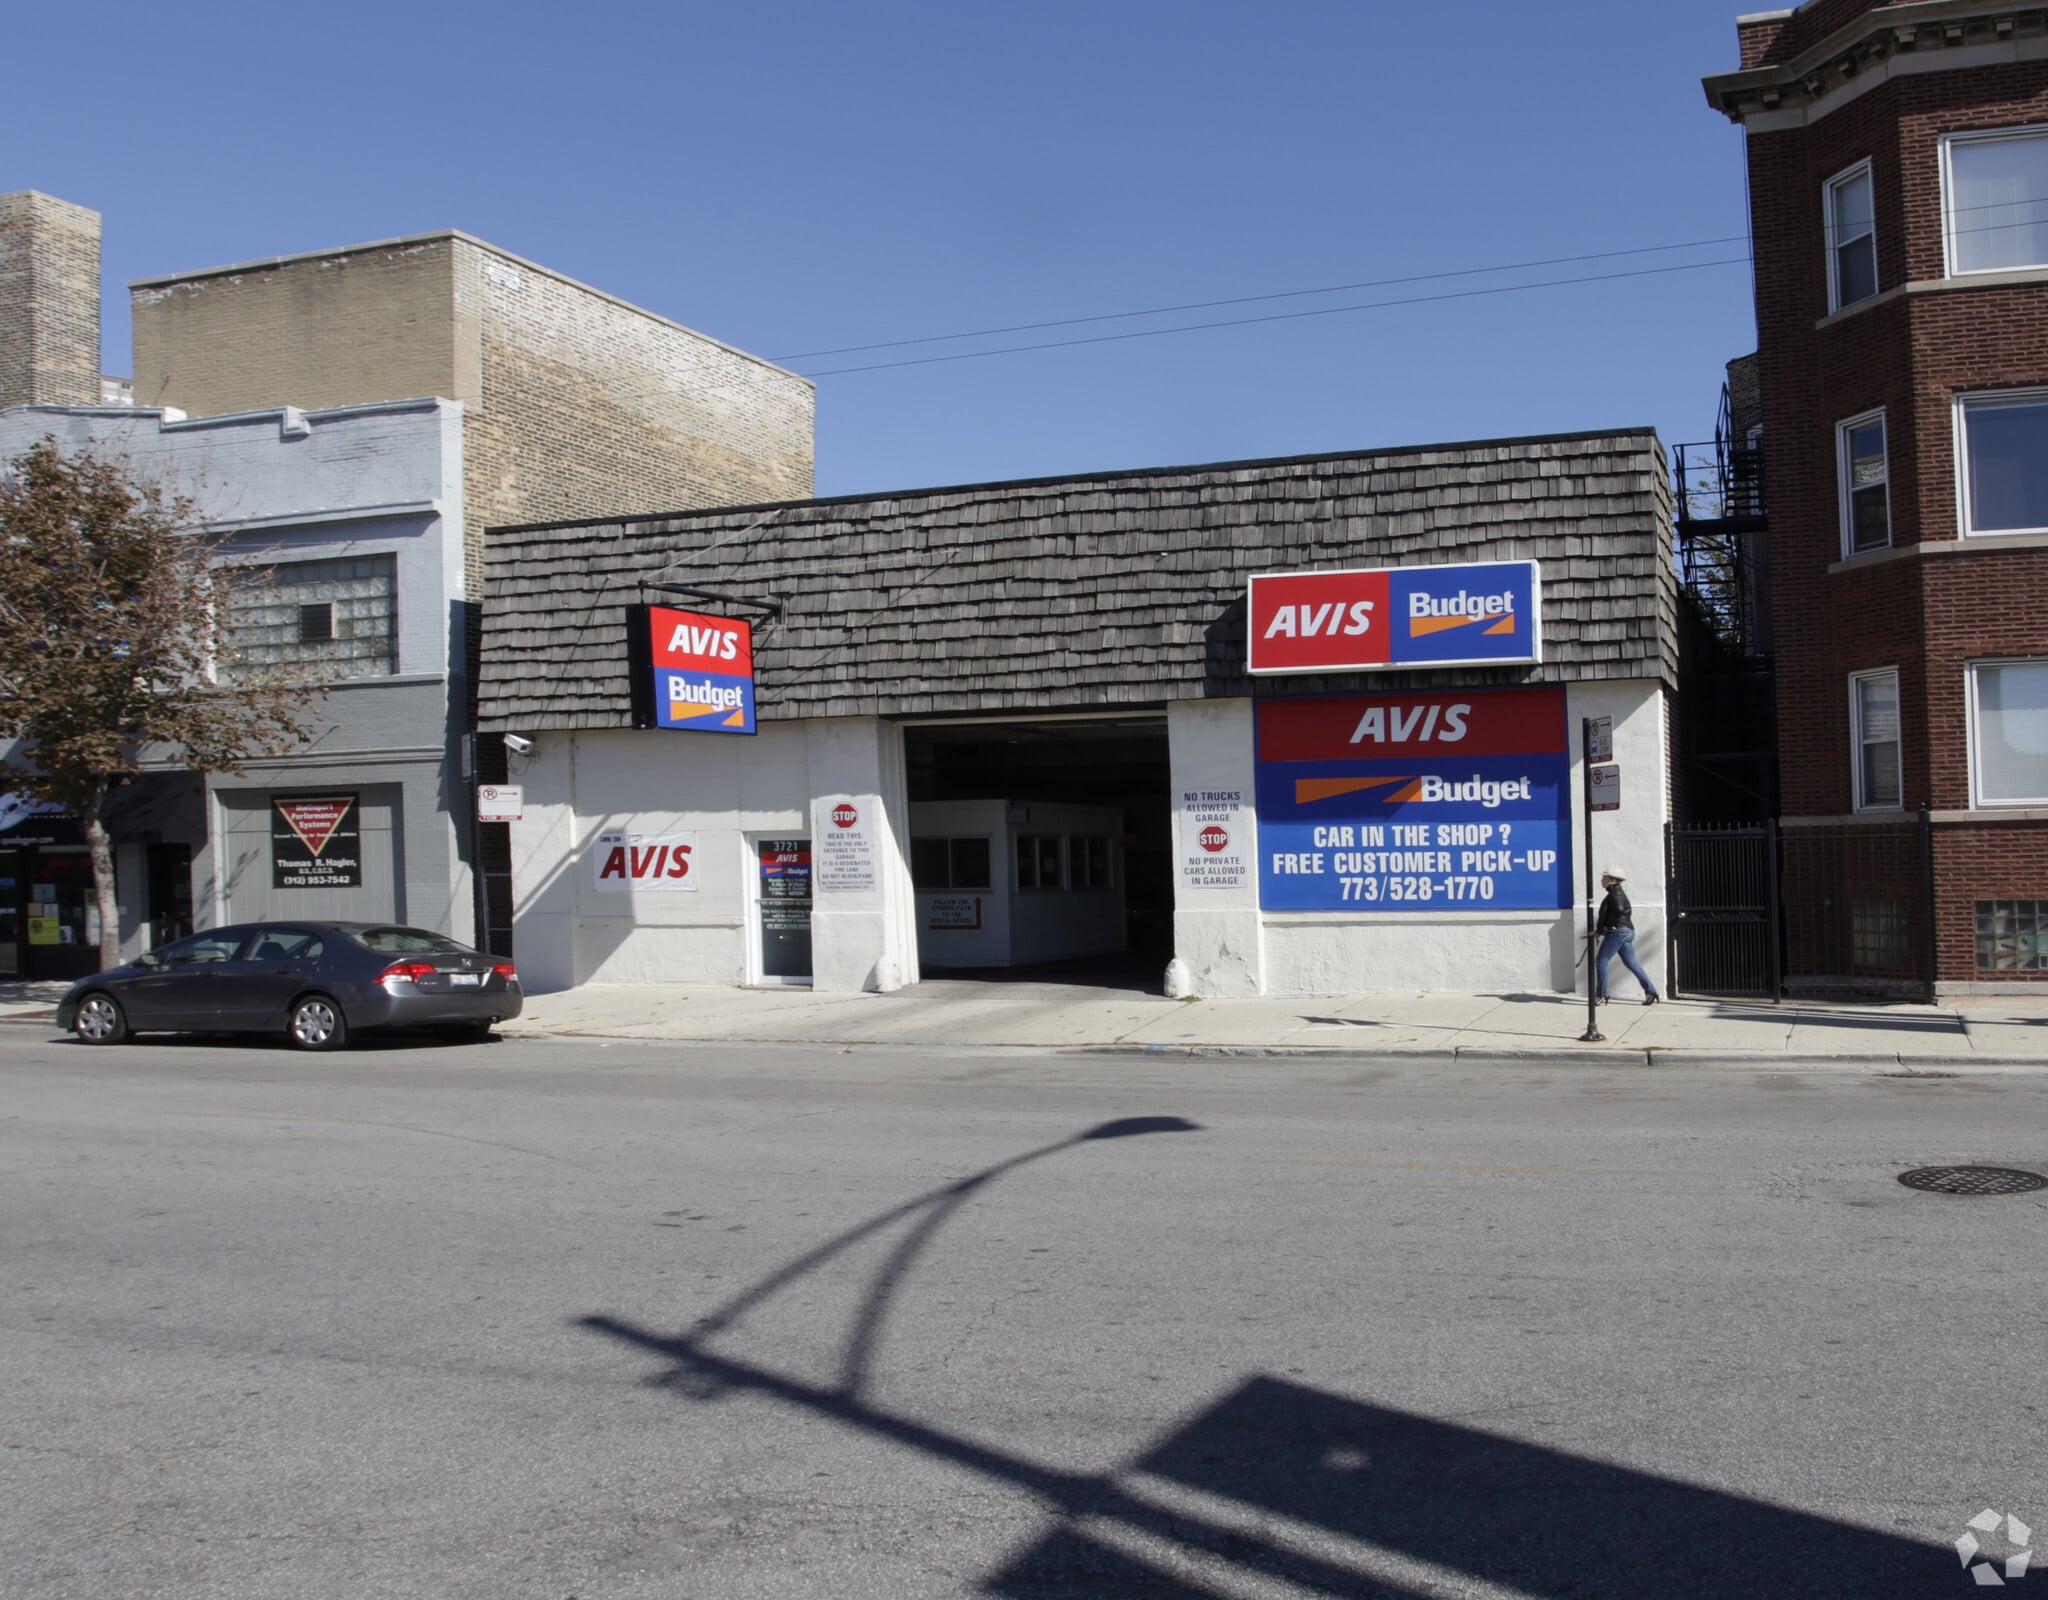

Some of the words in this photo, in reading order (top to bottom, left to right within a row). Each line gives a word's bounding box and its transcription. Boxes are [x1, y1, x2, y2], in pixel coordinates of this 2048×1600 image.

[1409, 590, 1515, 621] Budget
[1263, 601, 1374, 639] AVIS
[667, 624, 738, 660] AVIS
[668, 675, 743, 712] Budget
[1349, 703, 1472, 744] AVIS
[1184, 792, 1198, 801] NO
[1200, 791, 1241, 801] TRUCKS
[1421, 774, 1532, 808] Budget
[1186, 804, 1227, 812] ALLOWED
[1230, 803, 1239, 811] IN
[834, 811, 856, 821] STOP
[1195, 814, 1230, 822] GARAGE
[299, 822, 330, 830] Systems
[1200, 834, 1227, 844] STOP
[1313, 826, 1354, 848] CAR
[1361, 826, 1385, 847] IN
[1392, 825, 1430, 847] THE
[1437, 824, 1493, 846] SHOP
[1499, 824, 1511, 845] ?
[774, 841, 798, 851] 3721
[276, 859, 312, 867] Thomas
[600, 845, 692, 878] AVIS
[776, 854, 798, 862] AVIS
[1188, 857, 1200, 865] NO
[1204, 856, 1240, 864] PRIVATE
[1272, 853, 1325, 874] FREE
[1334, 852, 1451, 874] CUSTOMER
[1462, 850, 1556, 872] PICK-UP
[1184, 867, 1206, 875] CARS
[1208, 866, 1246, 875] ALLOWED
[284, 876, 306, 885] (312)
[1203, 876, 1239, 884] GARAGE
[1339, 876, 1494, 901] 773/528-1770
